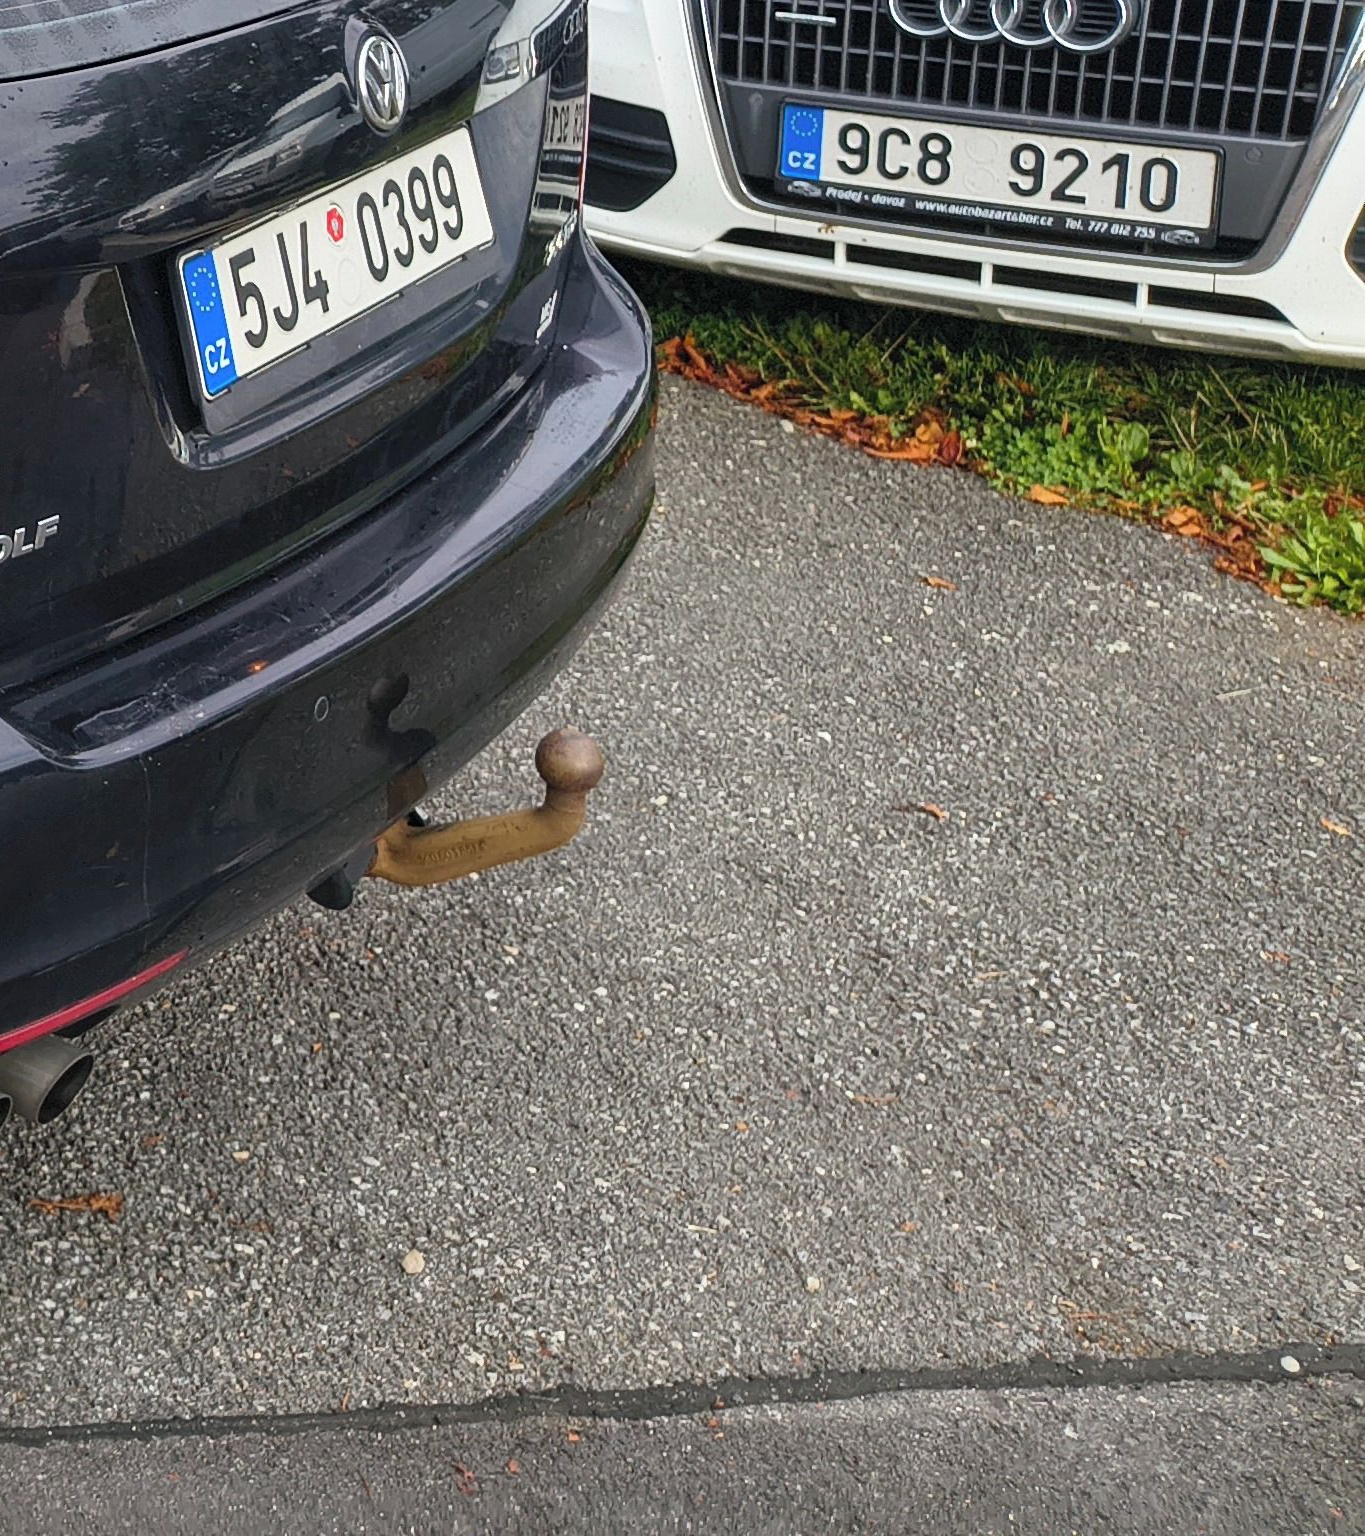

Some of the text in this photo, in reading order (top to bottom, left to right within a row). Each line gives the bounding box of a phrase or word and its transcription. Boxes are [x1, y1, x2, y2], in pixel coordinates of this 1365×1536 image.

[787, 151, 816, 170] CZ
[836, 122, 1178, 213] 9C8 9210
[228, 220, 330, 349] 5J4
[356, 153, 464, 282] 0399
[204, 337, 231, 375] CZ
